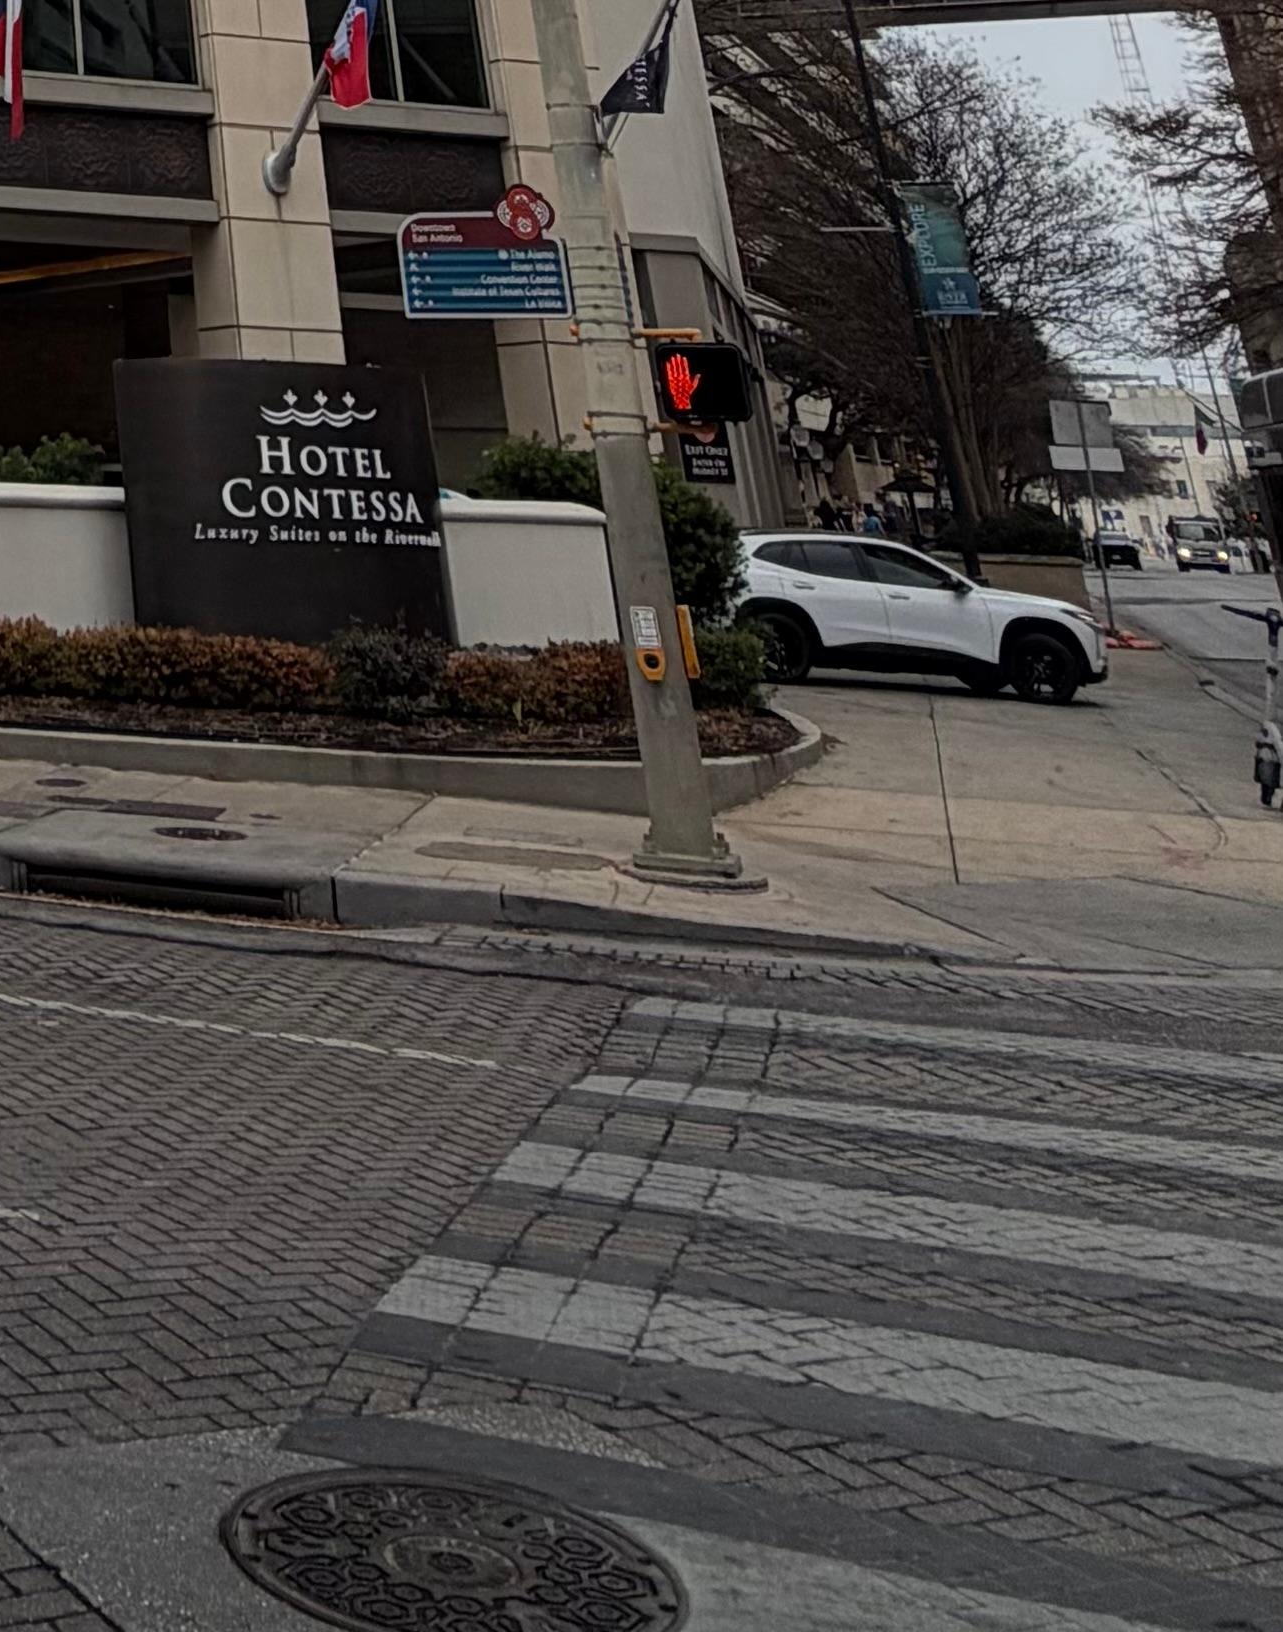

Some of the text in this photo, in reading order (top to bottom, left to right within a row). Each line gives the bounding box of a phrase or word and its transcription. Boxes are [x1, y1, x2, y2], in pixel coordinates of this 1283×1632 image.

[411, 224, 456, 232] Downtown
[412, 234, 463, 243] San Antonio
[909, 204, 937, 267] EXPLORE
[480, 275, 558, 284] Convention Center
[256, 435, 391, 479] HOTEL
[222, 477, 424, 524] CONTESSA
[194, 523, 442, 547] Luxury Suites on the Riverwalk
